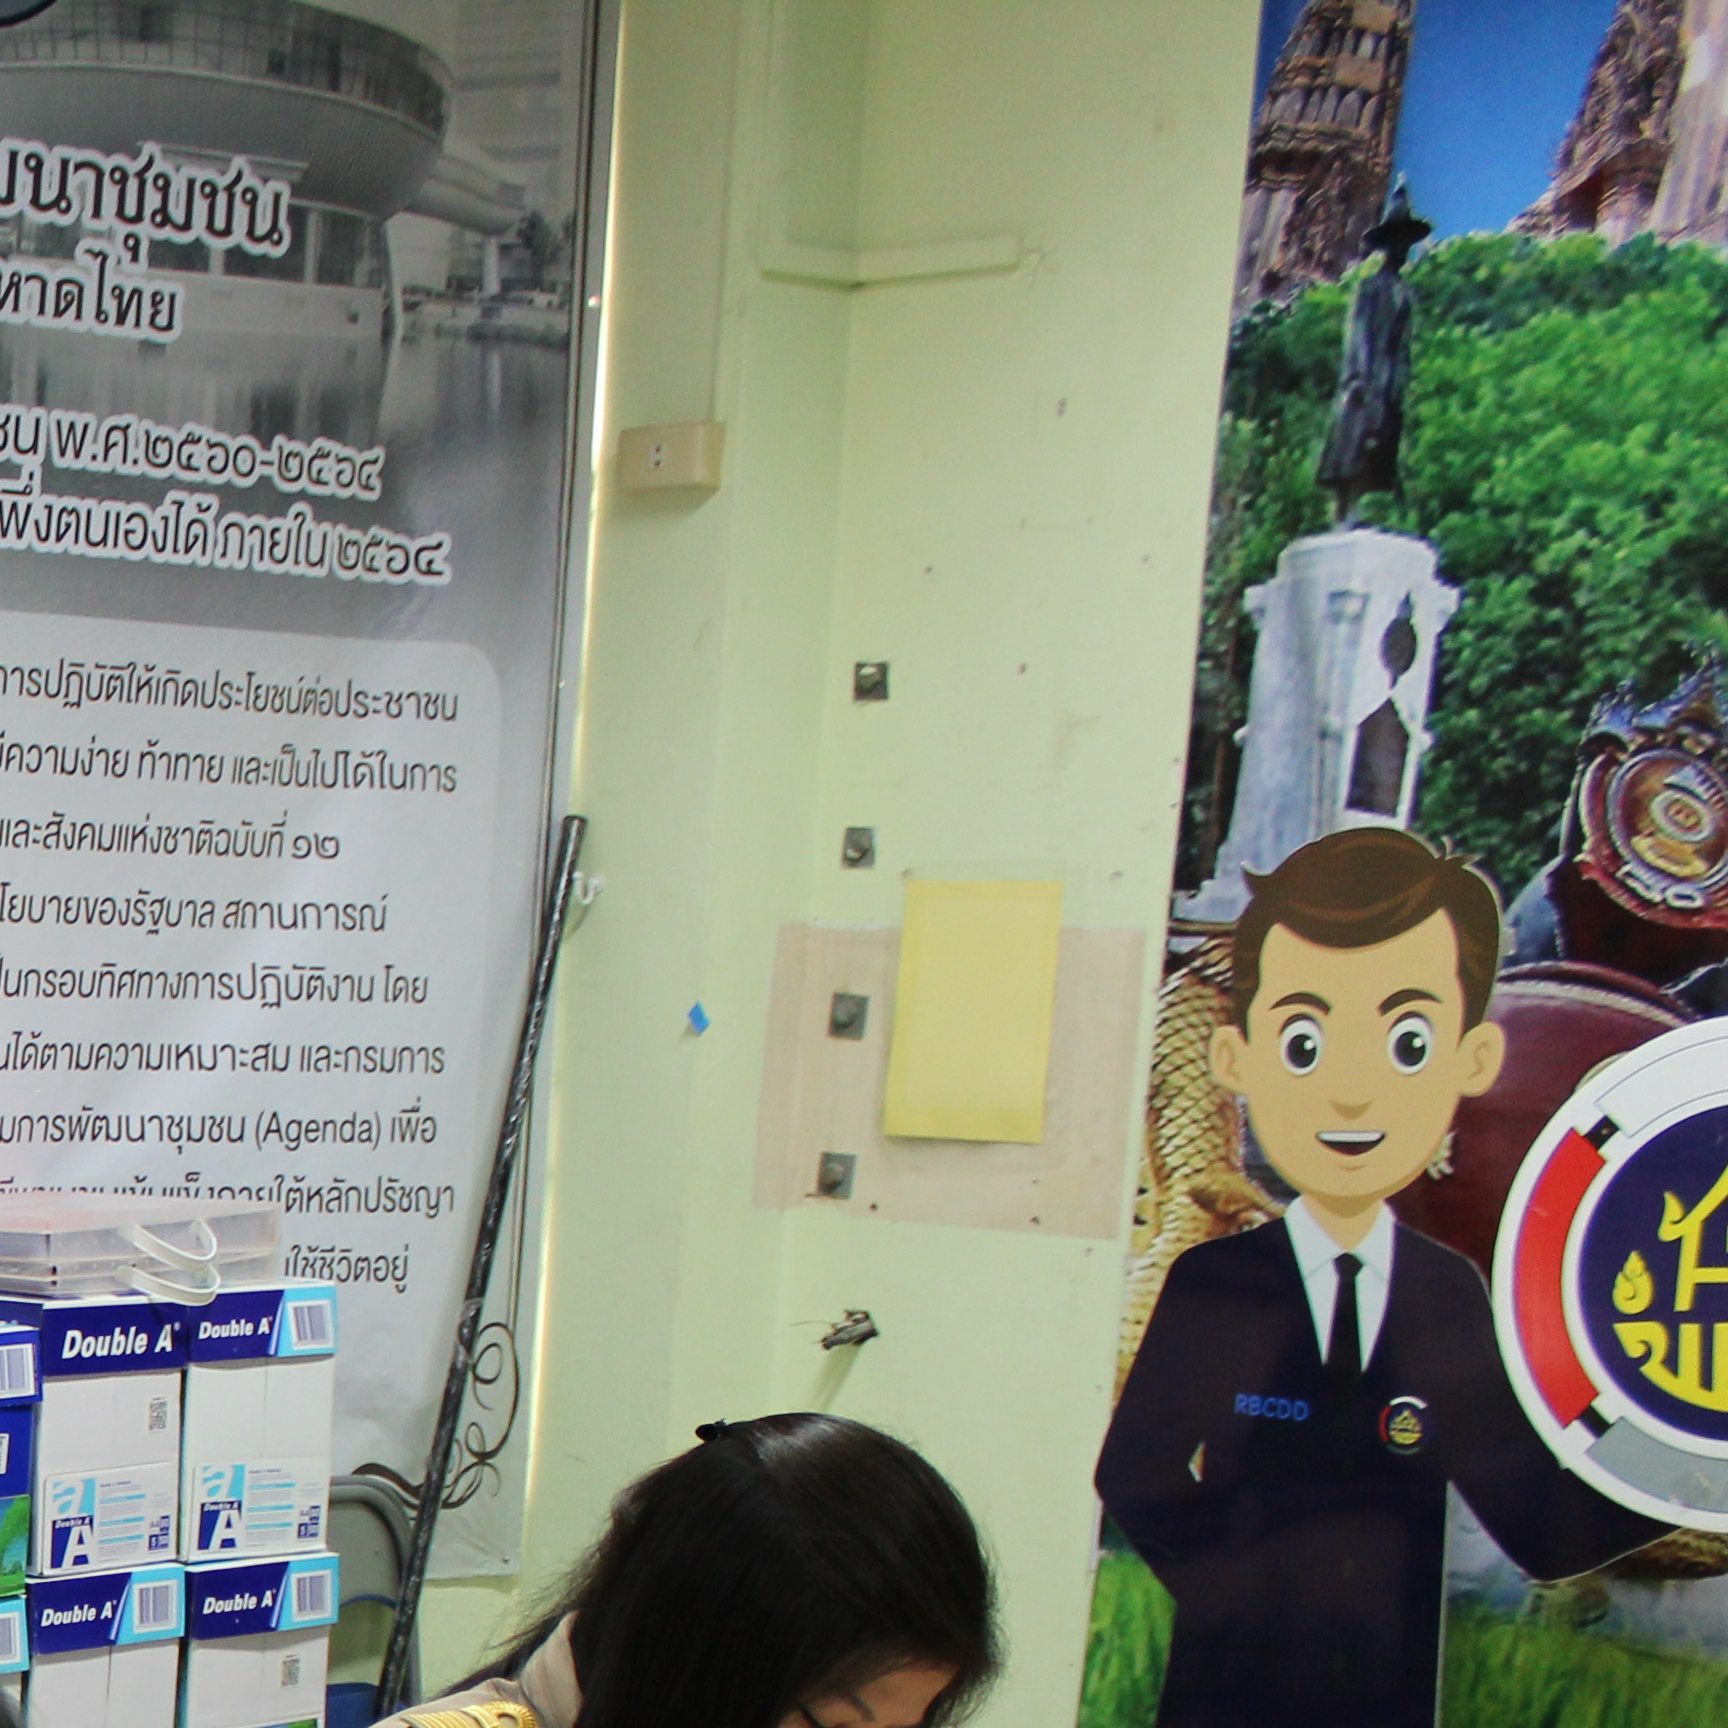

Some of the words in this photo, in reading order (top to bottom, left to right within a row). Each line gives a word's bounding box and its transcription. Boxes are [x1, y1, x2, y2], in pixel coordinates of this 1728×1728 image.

[55, 416, 382, 492] พ.ศ.๒๕๖๐-๒๕๖๔
[221, 511, 326, 567] ภายใน
[336, 531, 444, 577] ๒๕๖๔
[138, 740, 225, 782] ท้าทาย
[232, 737, 458, 795] และเป็นไปได้ในการ
[290, 831, 340, 860] ๑๒
[222, 892, 387, 933] สถานการณ์
[383, 964, 428, 1004] โดย
[299, 1037, 445, 1075] และกรมการ
[255, 1108, 382, 1152] (Agenda)
[390, 1096, 438, 1145] เพื่อ
[61, 1325, 149, 1360] Double
[155, 1322, 175, 1353] A
[198, 1317, 254, 1340] Double
[258, 1316, 272, 1335] A
[40, 1603, 96, 1628] Double
[100, 1601, 114, 1620] A
[202, 1594, 258, 1616] Double
[260, 1589, 274, 1609] A
